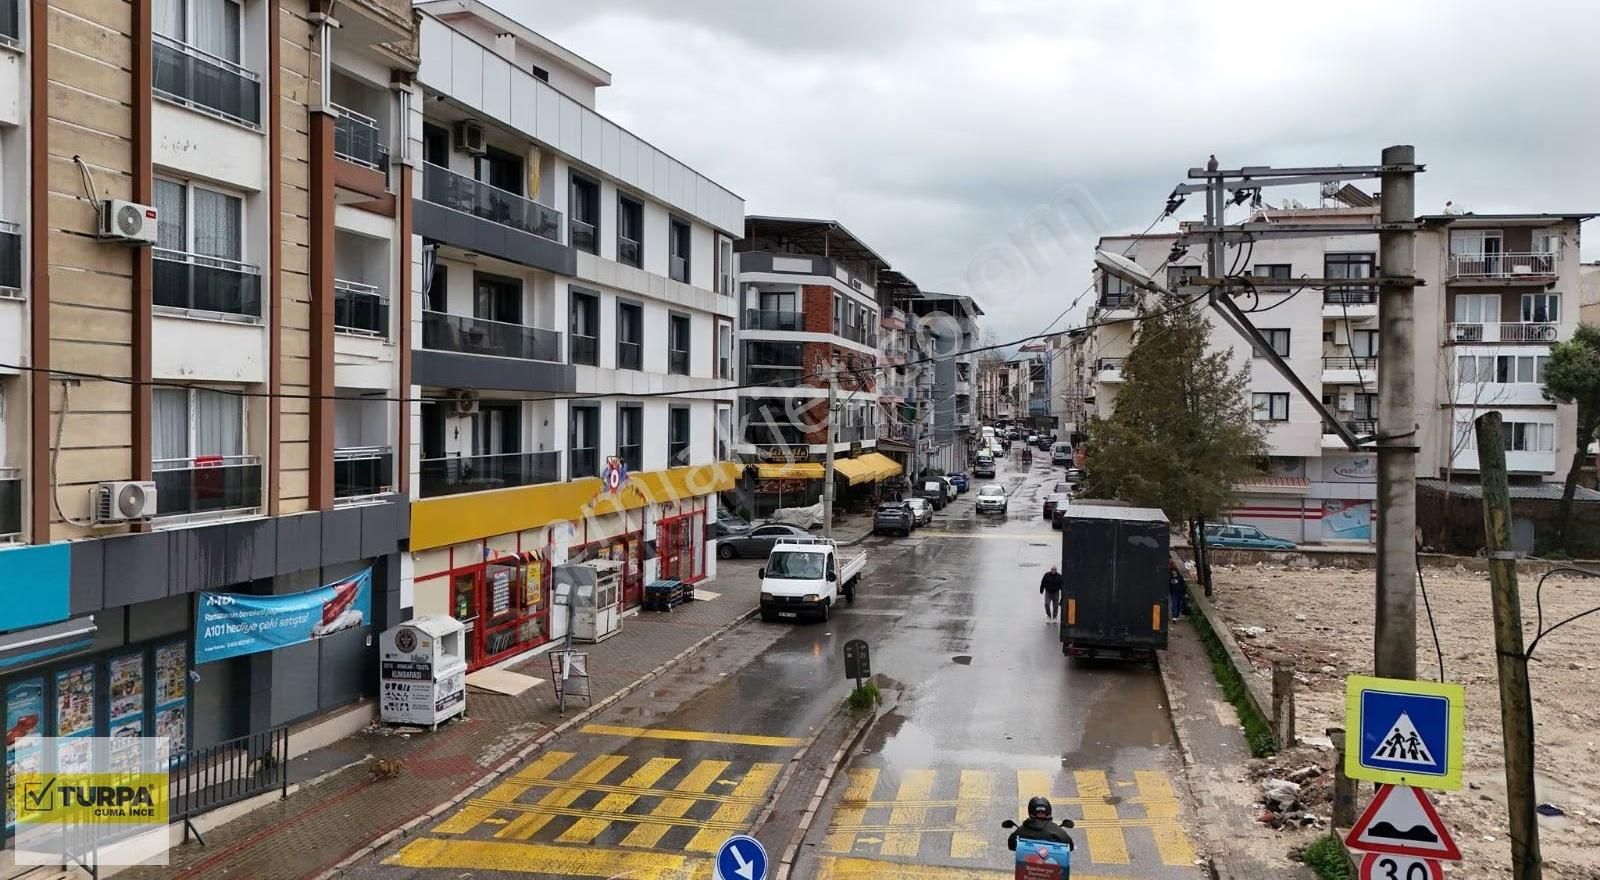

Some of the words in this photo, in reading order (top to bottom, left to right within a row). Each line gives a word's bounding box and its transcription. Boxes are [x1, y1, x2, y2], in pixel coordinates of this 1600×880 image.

[204, 624, 225, 638] A101
[226, 622, 257, 634] hediye
[1379, 858, 1428, 880] 30
